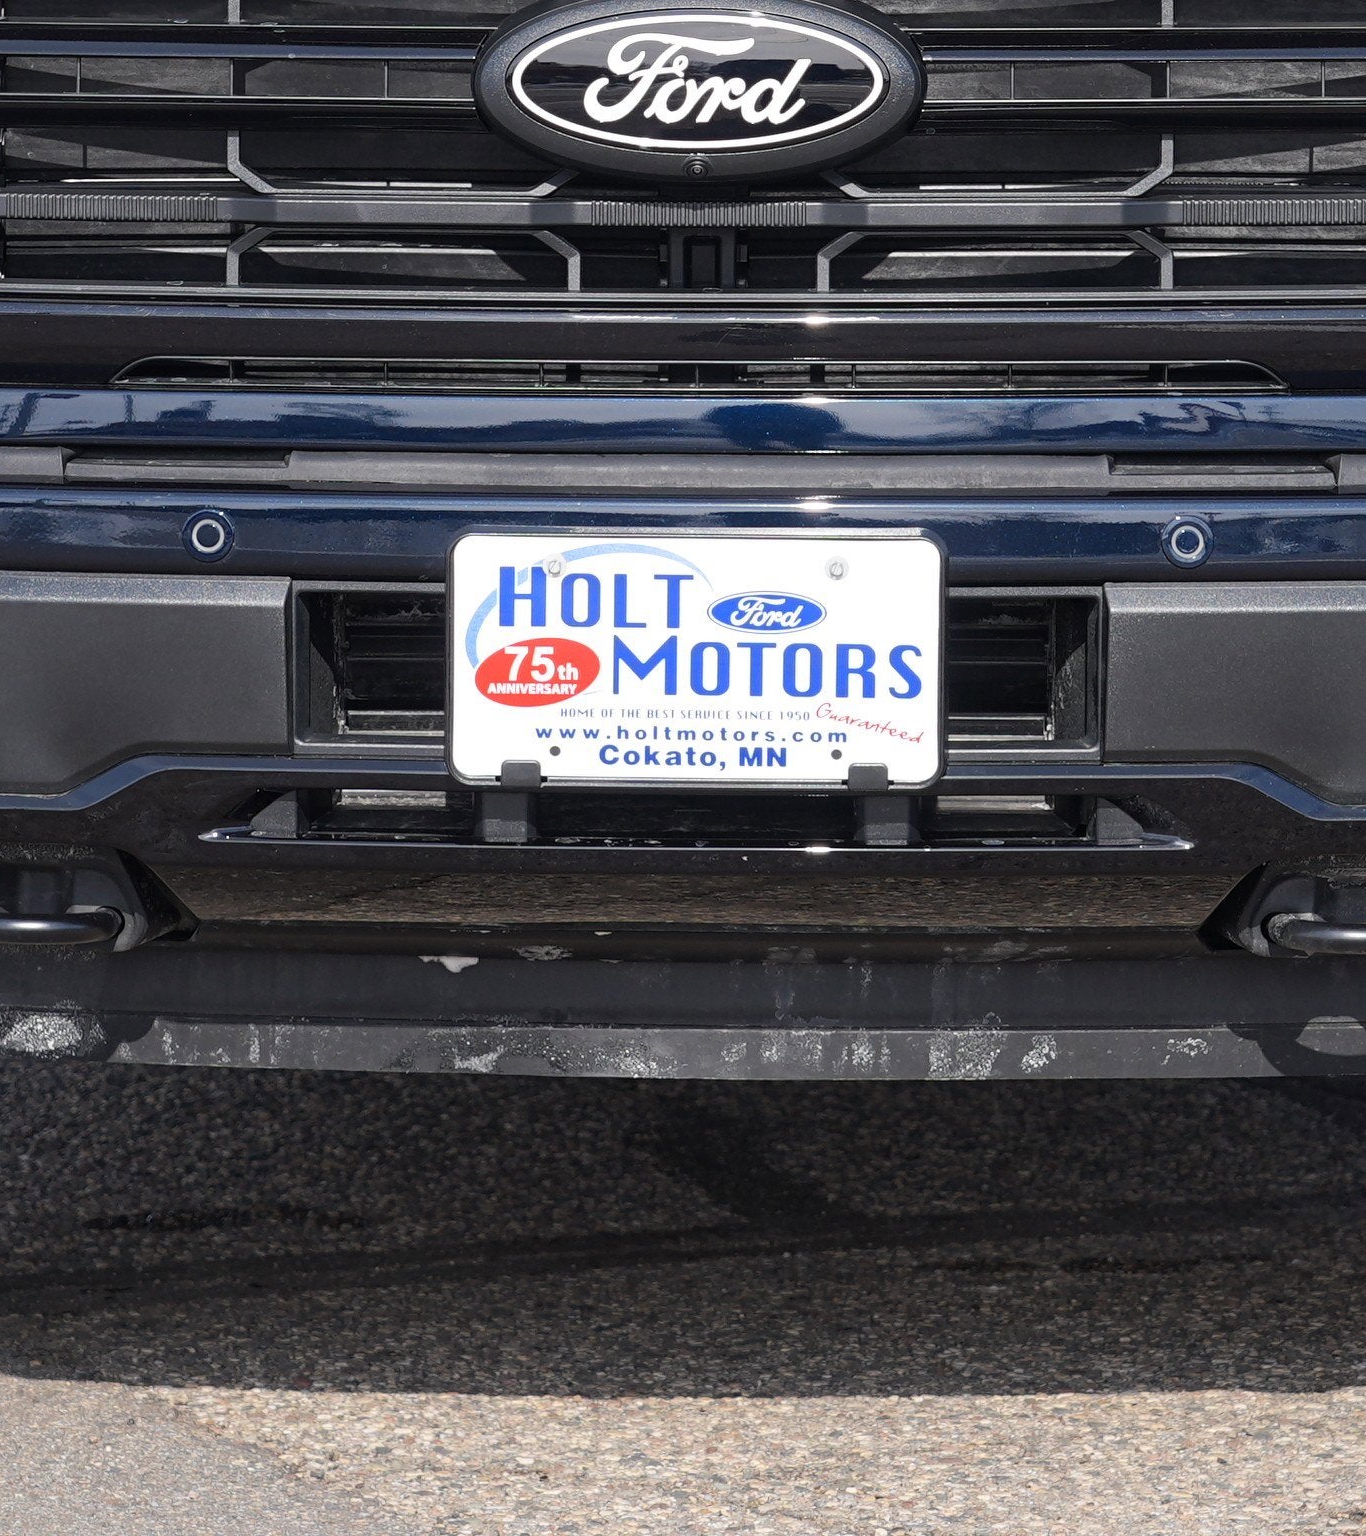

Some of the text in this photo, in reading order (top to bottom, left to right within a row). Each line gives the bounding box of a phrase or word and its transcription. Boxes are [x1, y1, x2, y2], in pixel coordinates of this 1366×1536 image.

[583, 32, 812, 125] Ford
[499, 566, 694, 629] HOLT
[729, 596, 805, 628] Ford
[504, 646, 579, 683] 75th
[612, 634, 923, 700] MOTORS
[487, 682, 578, 696] ANNIVERSARY
[535, 726, 848, 743] www.holtmotors.com
[560, 702, 924, 744] HOME OF THE BEST SERVICE SINCE 1950 Guaranteed
[598, 744, 788, 772] Cokato, MN
